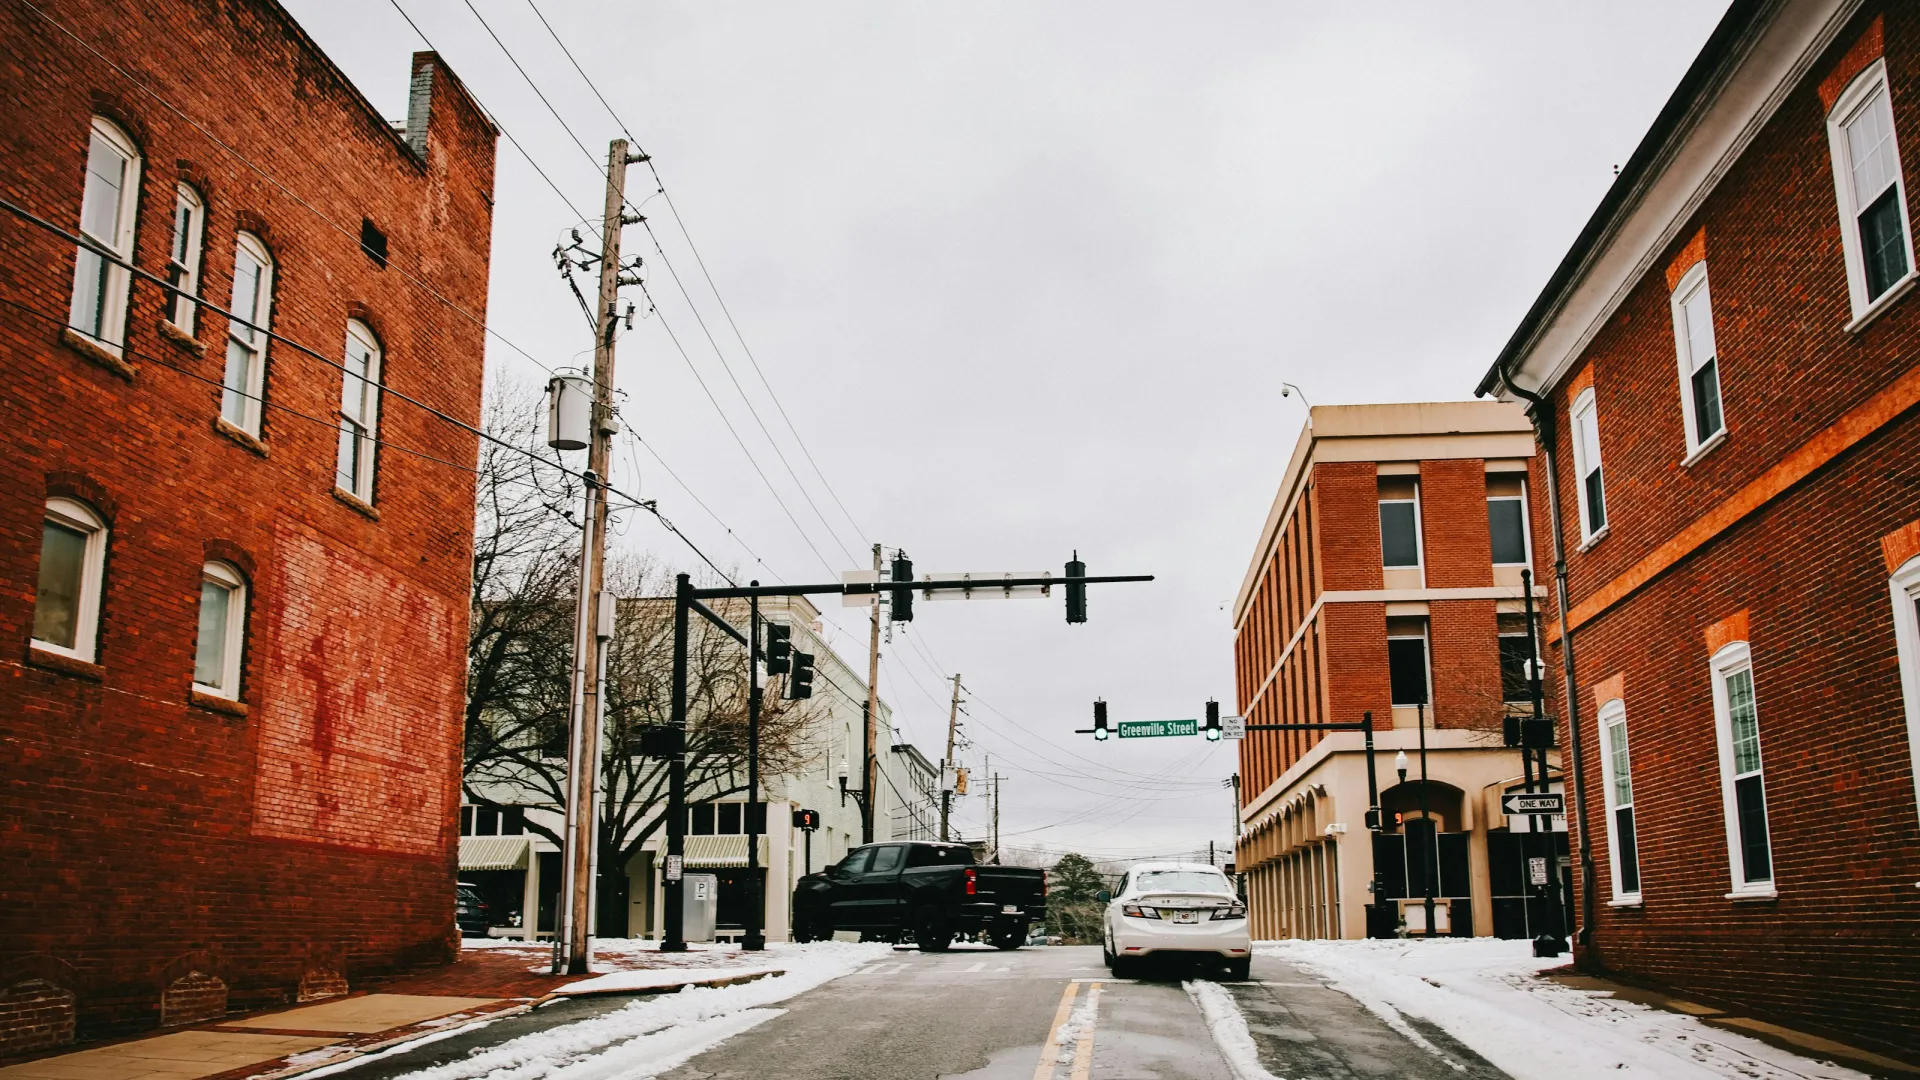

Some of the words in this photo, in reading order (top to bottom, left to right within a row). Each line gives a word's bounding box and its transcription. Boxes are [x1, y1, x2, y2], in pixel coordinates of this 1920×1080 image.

[1121, 723, 1165, 737] Greenville
[1168, 722, 1195, 735] Street
[1519, 800, 1537, 808] ONE
[1539, 799, 1557, 807] WAY
[804, 814, 811, 825] 9
[698, 883, 705, 892] P
